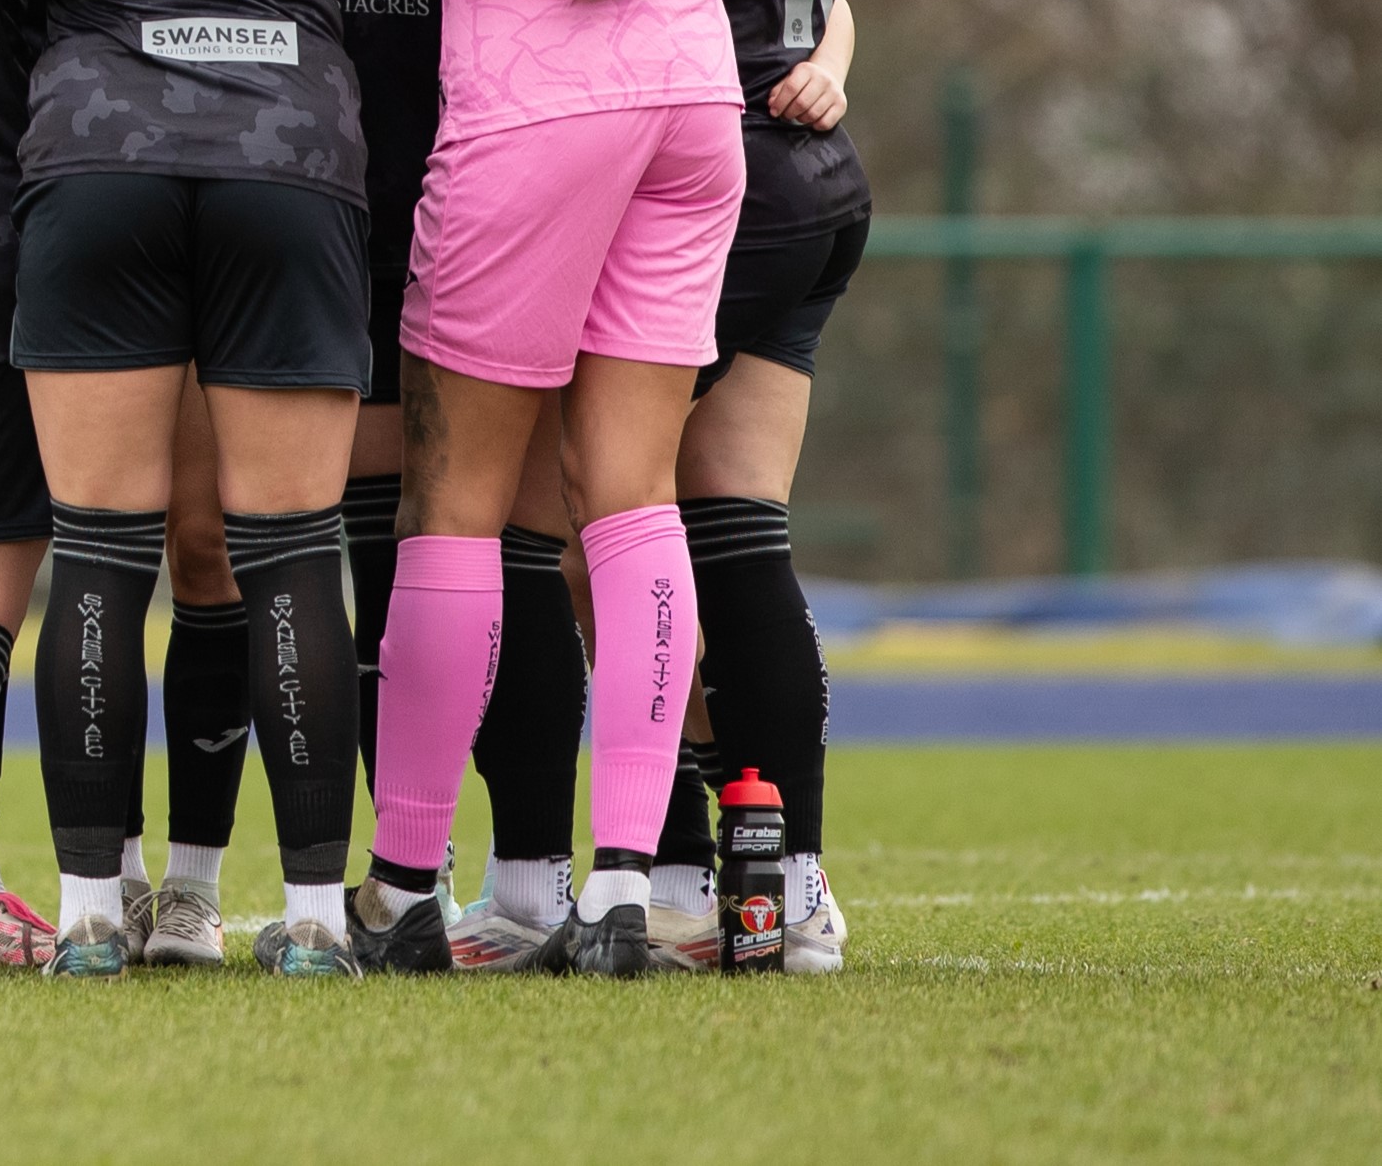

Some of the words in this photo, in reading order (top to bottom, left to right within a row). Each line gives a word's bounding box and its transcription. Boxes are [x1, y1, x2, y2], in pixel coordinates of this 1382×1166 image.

[152, 26, 288, 46] SWANSEA
[228, 46, 284, 57] SOCIETY
[651, 579, 674, 648] SWANSEA
[78, 593, 104, 672] SWANSEA
[270, 594, 298, 676] SWANSEA
[653, 653, 670, 691] CITY
[81, 676, 106, 719] CITY
[279, 680, 306, 725] CITY
[732, 843, 780, 852] SPORT
[733, 826, 782, 838] Carabao
[556, 870, 565, 905] GRIPS
[805, 875, 814, 911] GRIPS
[734, 927, 782, 947] Carabao
[734, 944, 783, 962] SPORT
